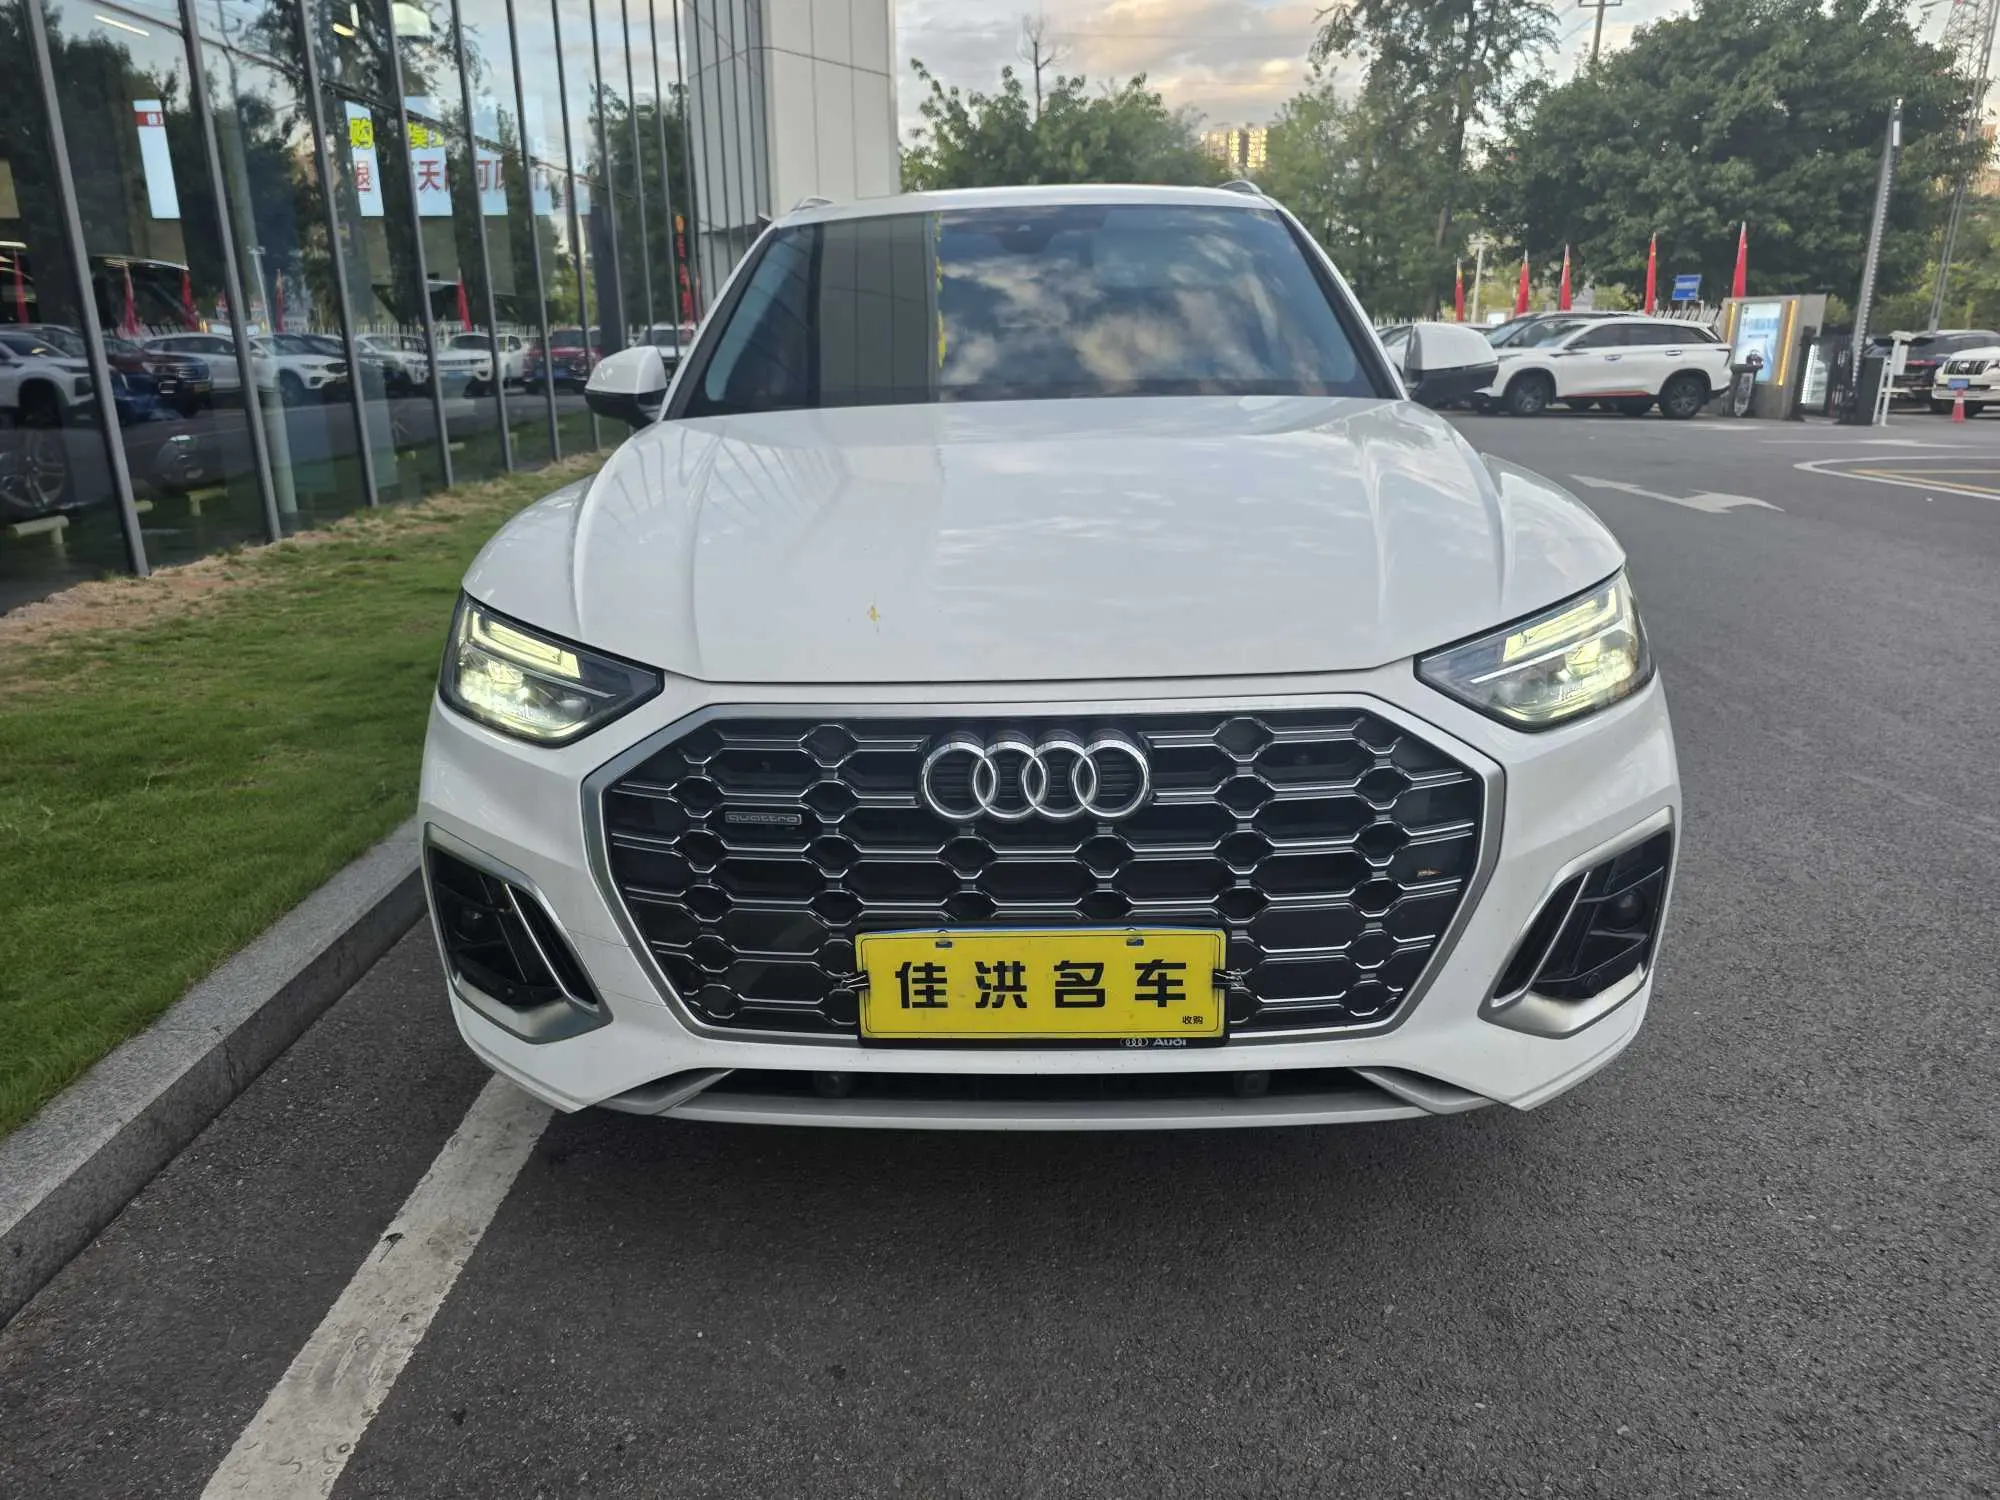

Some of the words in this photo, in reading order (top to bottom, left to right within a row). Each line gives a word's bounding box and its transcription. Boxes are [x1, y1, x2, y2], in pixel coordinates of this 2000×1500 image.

[727, 813, 799, 824] quattro
[894, 959, 1187, 1008] 佳洪名车
[1182, 1015, 1204, 1025] 收购
